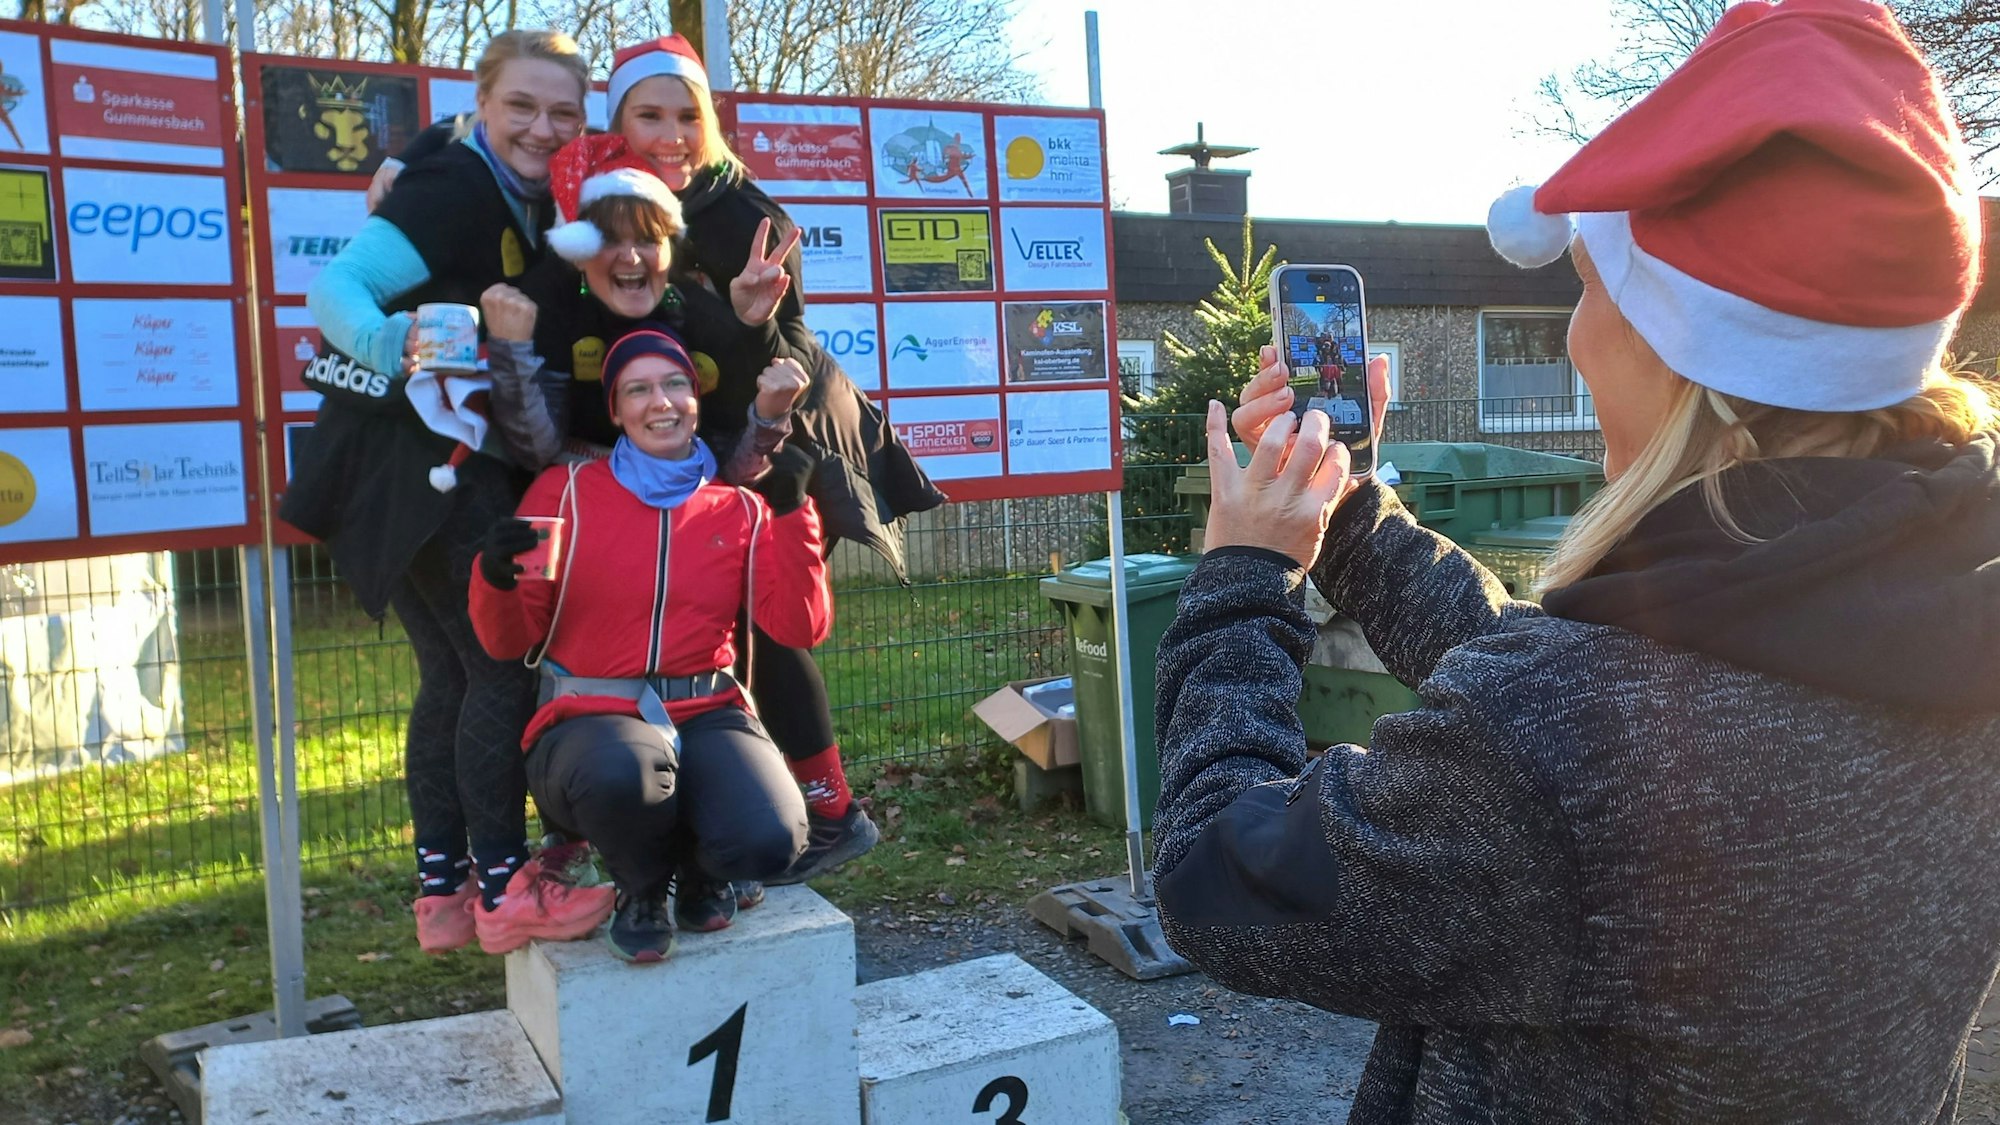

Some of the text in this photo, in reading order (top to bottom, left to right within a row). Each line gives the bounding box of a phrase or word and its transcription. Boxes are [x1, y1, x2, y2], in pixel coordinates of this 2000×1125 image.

[102, 90, 175, 111] Sparkasse
[103, 109, 205, 131] Gummersbach
[774, 140, 829, 155] Sparkasse
[1048, 137, 1072, 150] bkk
[775, 156, 851, 169] Gummersbach
[1049, 154, 1090, 167] melitta
[69, 201, 224, 254] eepos
[800, 226, 842, 248] MS
[1011, 227, 1083, 261] VELLER
[1028, 261, 1049, 269] Design
[1053, 322, 1083, 332] KSL
[814, 329, 875, 355] pos
[925, 336, 987, 348] AggerEnergie
[304, 353, 390, 397] adidas
[913, 424, 966, 438] SPORT
[1009, 439, 1025, 447] BSP
[688, 1001, 748, 1123] 1
[972, 1075, 1029, 1125] 3
